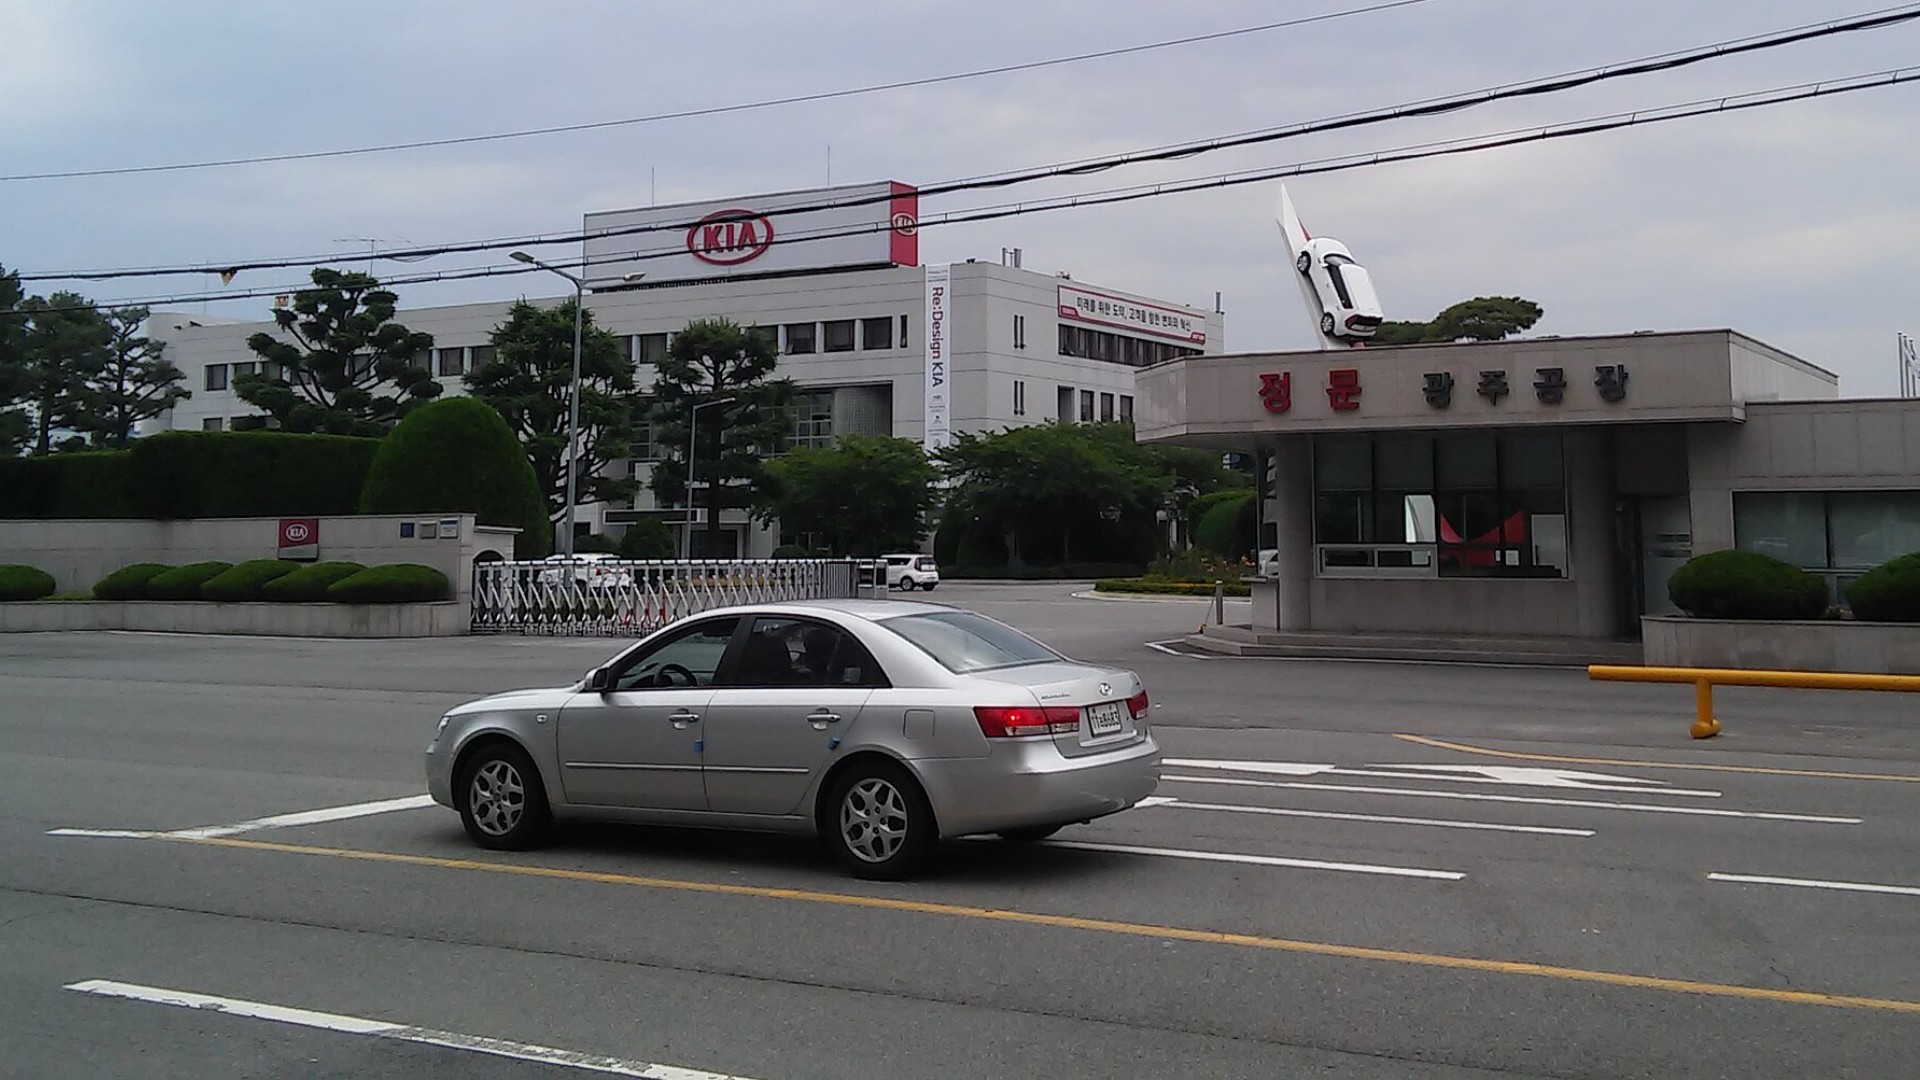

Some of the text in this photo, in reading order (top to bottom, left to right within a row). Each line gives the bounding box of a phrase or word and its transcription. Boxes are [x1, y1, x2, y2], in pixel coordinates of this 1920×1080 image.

[704, 222, 757, 253] KIA
[930, 287, 944, 359] Re:Design
[932, 362, 944, 388] KIA
[289, 528, 304, 537] KIA
